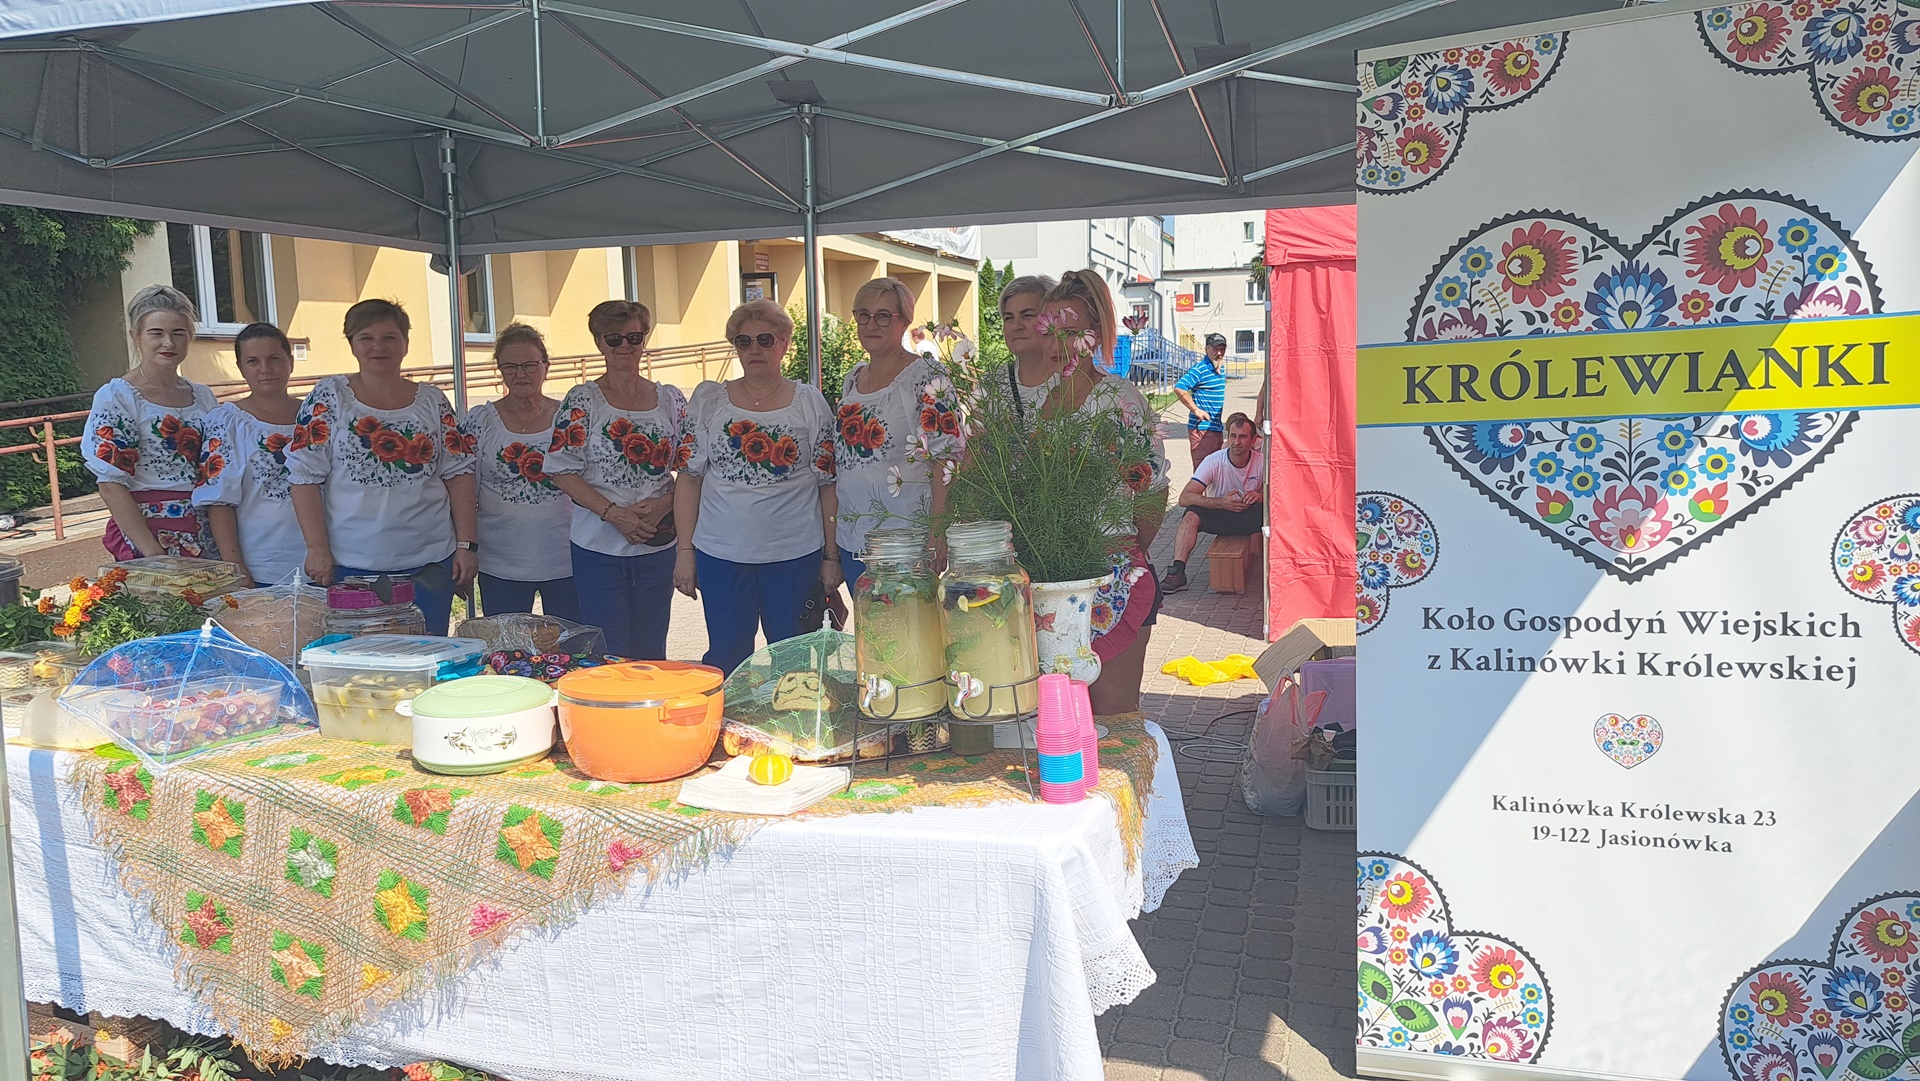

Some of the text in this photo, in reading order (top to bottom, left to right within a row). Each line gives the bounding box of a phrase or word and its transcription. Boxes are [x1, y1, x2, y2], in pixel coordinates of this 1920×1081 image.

[1402, 341, 1891, 405] KRÓLEWIANKI
[1421, 606, 1863, 643] Koło Gospodyń Wiejskich
[1427, 647, 1858, 689] z Kalinówki Królewskiej
[1492, 795, 1777, 826] Kalinówka Królewska 23
[1532, 825, 1733, 853] 19-122 Jasionówka
